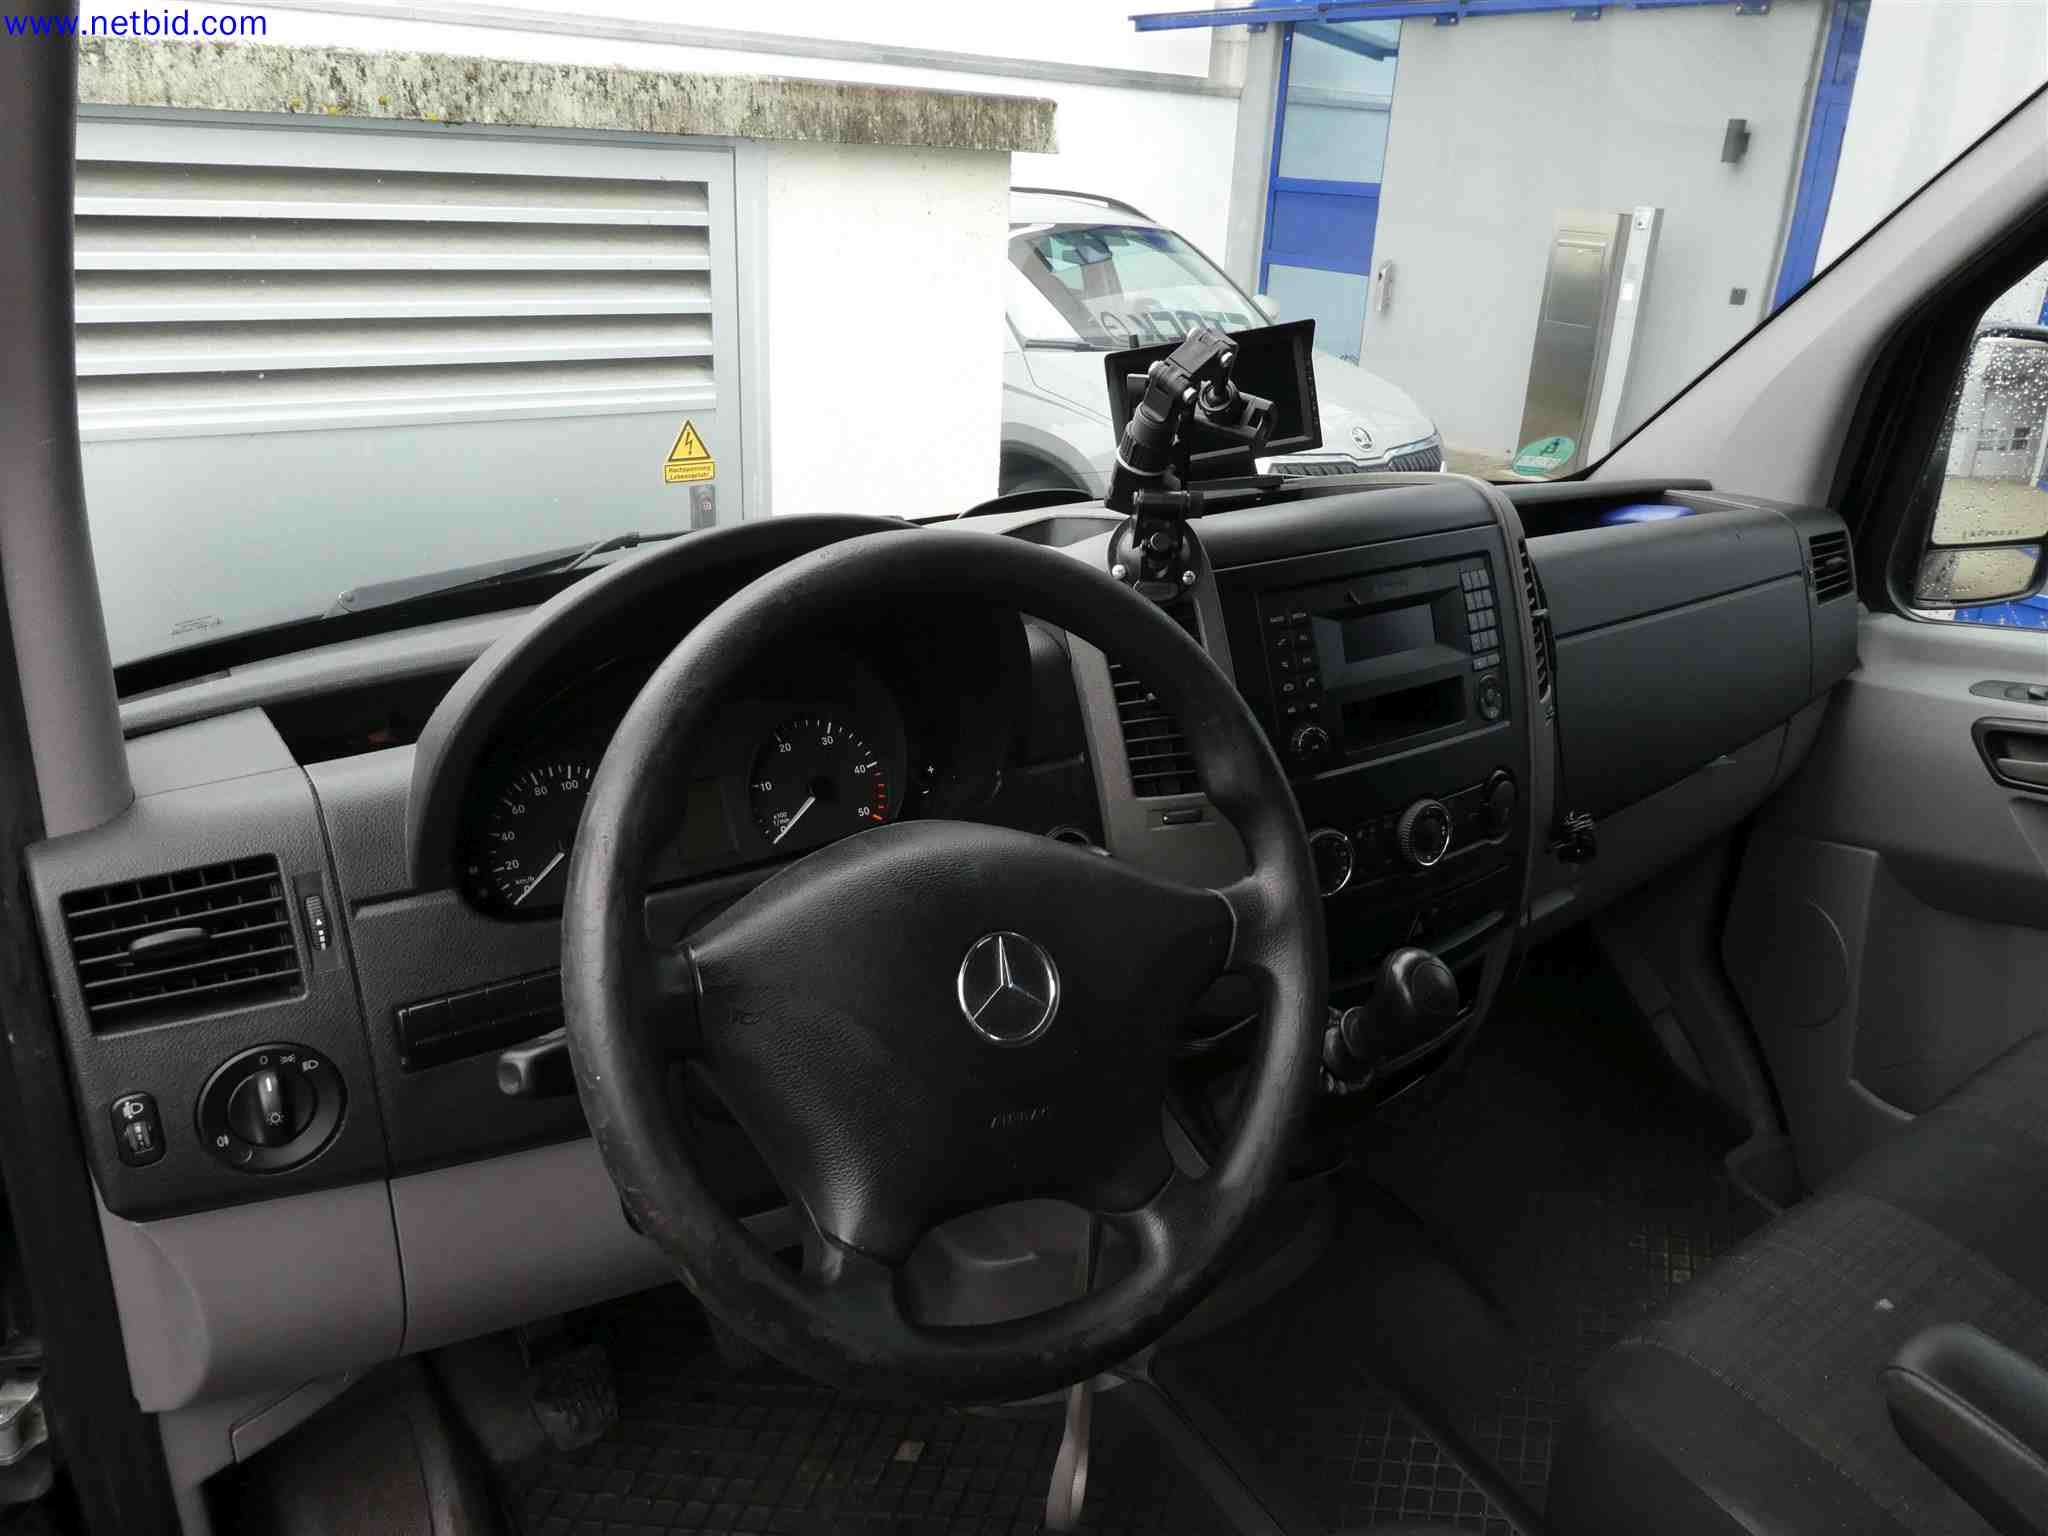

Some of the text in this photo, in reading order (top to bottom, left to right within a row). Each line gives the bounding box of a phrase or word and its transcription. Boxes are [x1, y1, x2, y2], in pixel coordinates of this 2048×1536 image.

[821, 736, 834, 746] 30
[778, 743, 792, 753] 20
[854, 764, 866, 774] 40
[560, 779, 579, 792] 100
[759, 782, 773, 792] 10
[533, 786, 548, 796] 80
[511, 804, 526, 815] 60
[858, 806, 871, 817] 50
[501, 831, 516, 841] 40
[504, 859, 520, 870] 20
